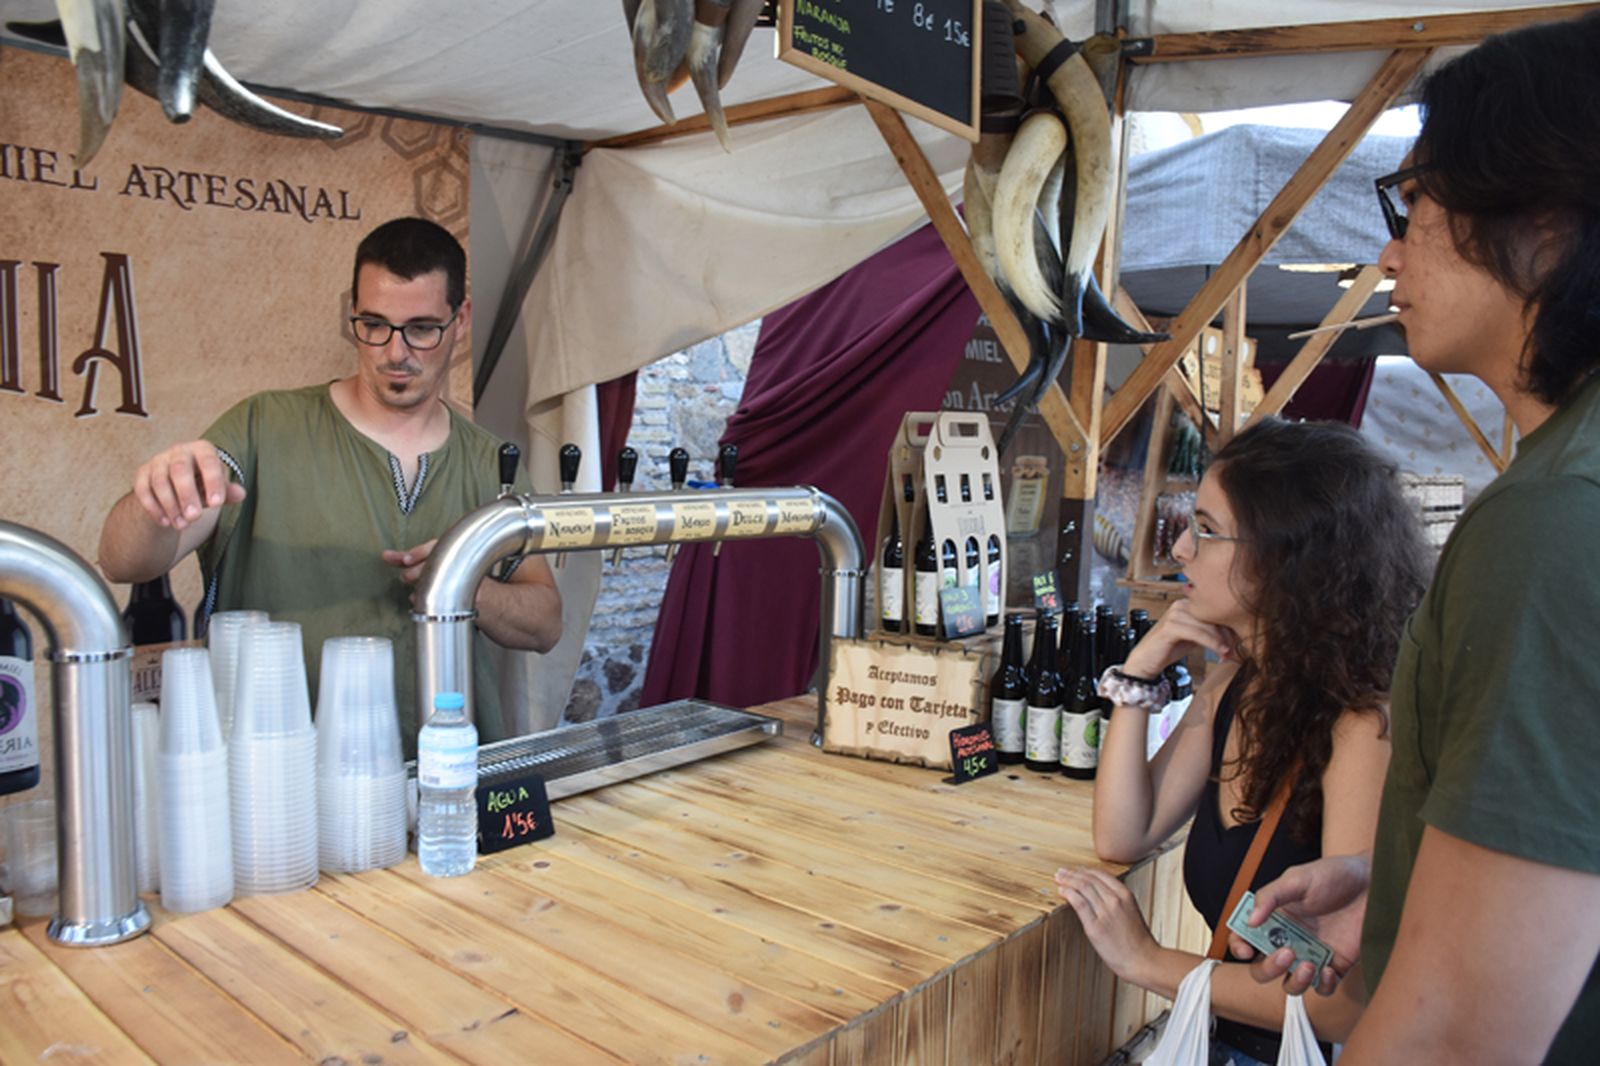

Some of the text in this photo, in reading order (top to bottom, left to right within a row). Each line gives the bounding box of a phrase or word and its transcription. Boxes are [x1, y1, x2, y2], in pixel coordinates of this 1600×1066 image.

[913, 3, 933, 31] 8€
[944, 19, 970, 47] 15€
[119, 164, 361, 223] ARTESANAL
[964, 339, 1003, 363] MIEL
[868, 665, 937, 687] Aceptamos
[835, 686, 968, 719] Pago con Tarjeta
[877, 719, 930, 740] Efectivo
[487, 786, 529, 813] AGUA
